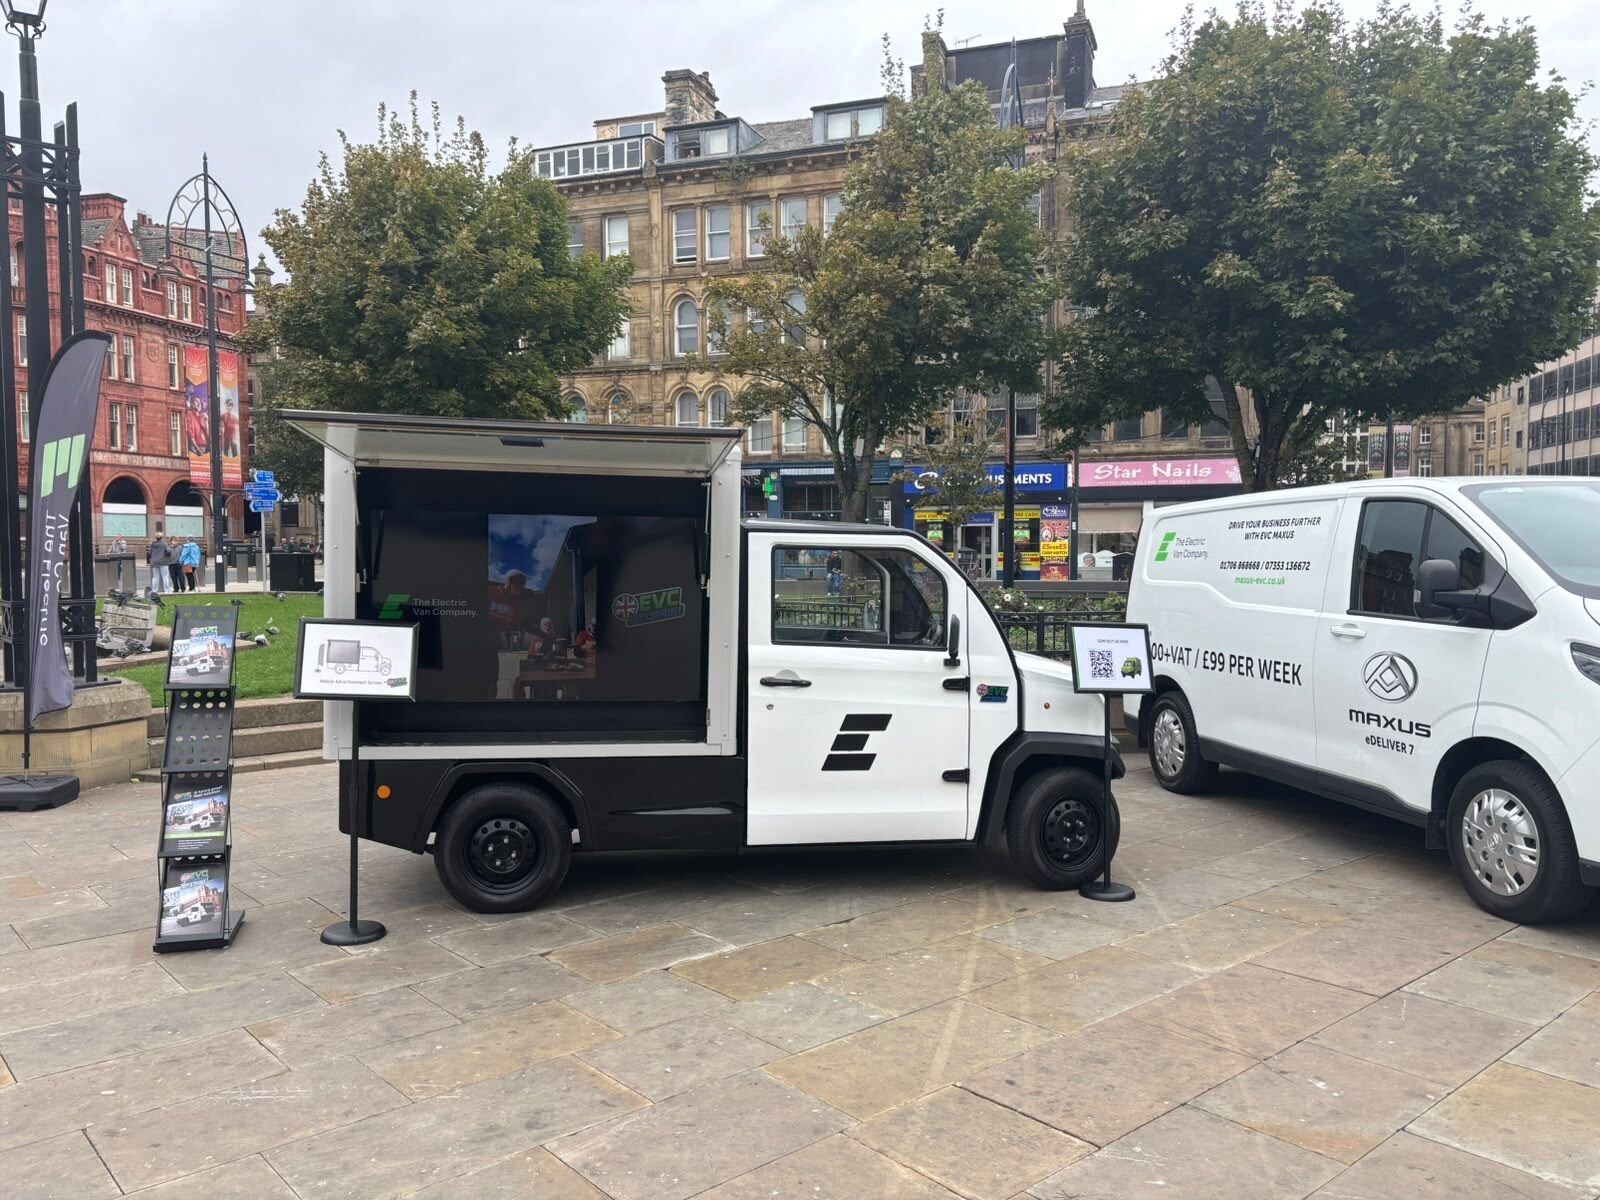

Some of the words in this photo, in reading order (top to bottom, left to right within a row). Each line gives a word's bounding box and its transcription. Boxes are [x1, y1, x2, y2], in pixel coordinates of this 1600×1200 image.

[1093, 464, 1142, 480] Star
[1151, 462, 1213, 478] Nails
[1228, 521, 1245, 530] DRIVE
[1245, 520, 1261, 529] YOUR
[1261, 518, 1291, 528] BUSINESS
[1290, 517, 1321, 527] FURTHER
[1175, 537, 1185, 546] The
[1185, 536, 1206, 546] Electric
[1244, 531, 1259, 540] WITH
[1260, 531, 1272, 540] EVC
[1272, 530, 1295, 540] MAXUS
[1219, 561, 1237, 570] 01706
[1285, 561, 1311, 571] 136672
[1234, 575, 1286, 586] maxus-evc.co.uk
[413, 598, 430, 606] The
[431, 598, 467, 606] Electric
[639, 590, 679, 611] EVC
[413, 607, 431, 616] Van
[1194, 648, 1200, 669] /
[1202, 650, 1225, 672] £99
[1229, 654, 1254, 678] PER
[1258, 658, 1302, 686] WEEK
[1349, 709, 1431, 738] MAXUS
[1365, 735, 1407, 754] eDELIVER
[1408, 744, 1415, 755] 7
